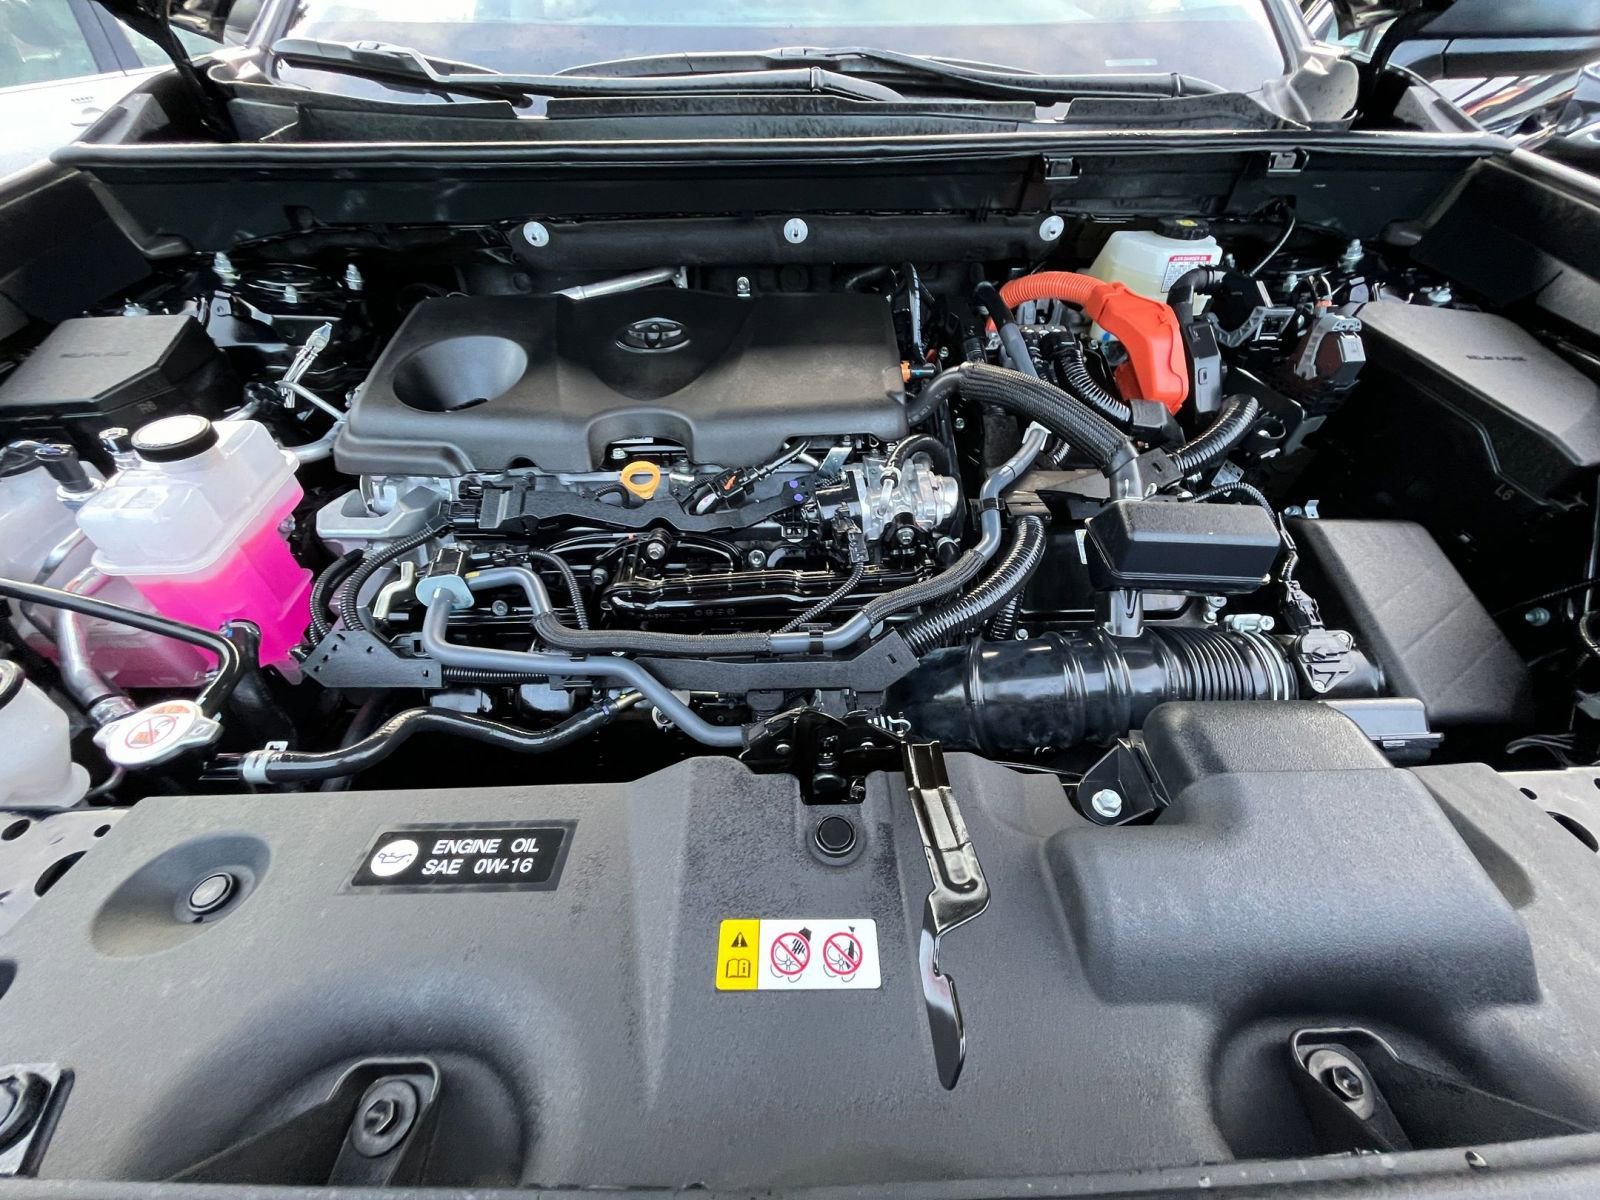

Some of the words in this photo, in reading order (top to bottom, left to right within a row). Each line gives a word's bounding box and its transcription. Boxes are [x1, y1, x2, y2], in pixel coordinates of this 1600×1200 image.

[431, 838, 502, 854] ENGINE
[510, 837, 540, 853] OIL
[421, 858, 465, 875] SAE
[473, 857, 534, 874] 0W-16
